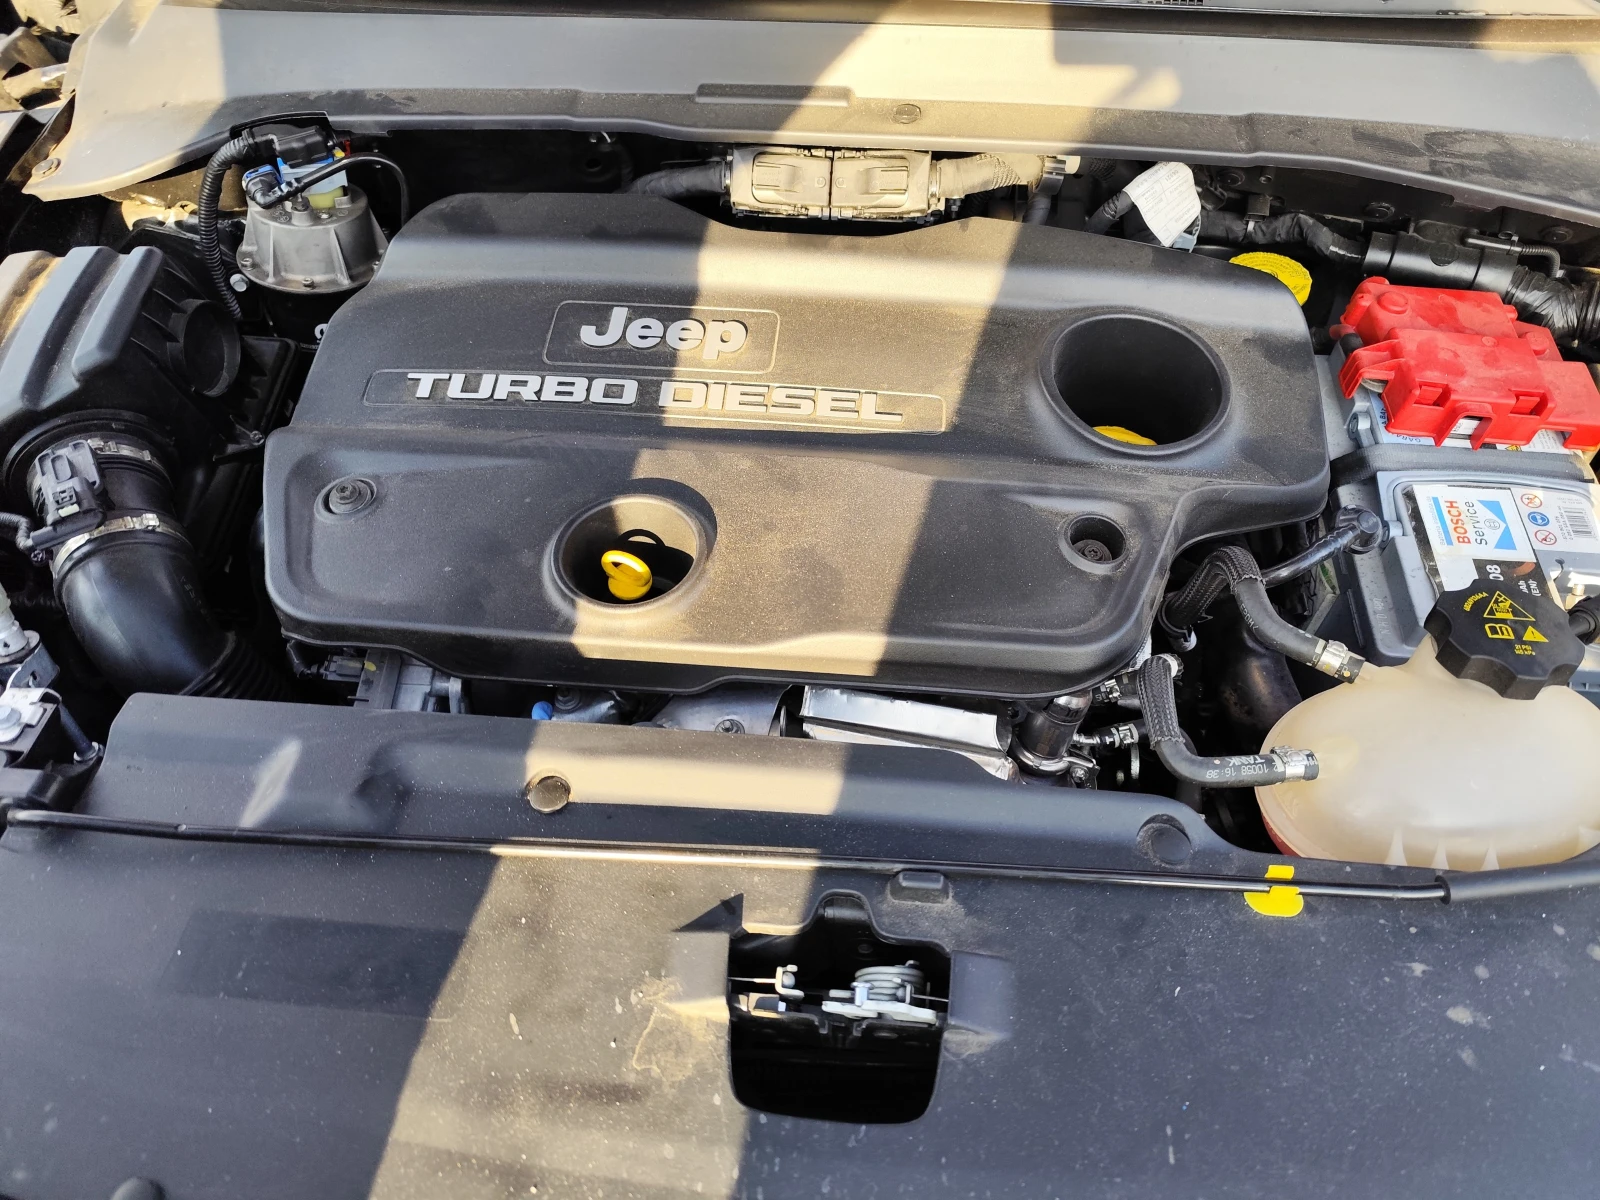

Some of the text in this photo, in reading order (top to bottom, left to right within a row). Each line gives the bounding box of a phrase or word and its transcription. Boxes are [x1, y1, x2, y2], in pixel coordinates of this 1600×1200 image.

[579, 307, 748, 360] Jeep
[407, 373, 903, 422] TURBO DIESEL
[1444, 500, 1471, 544] BOSCH
[1464, 501, 1488, 545] Service
[1225, 755, 1265, 767] TANK
